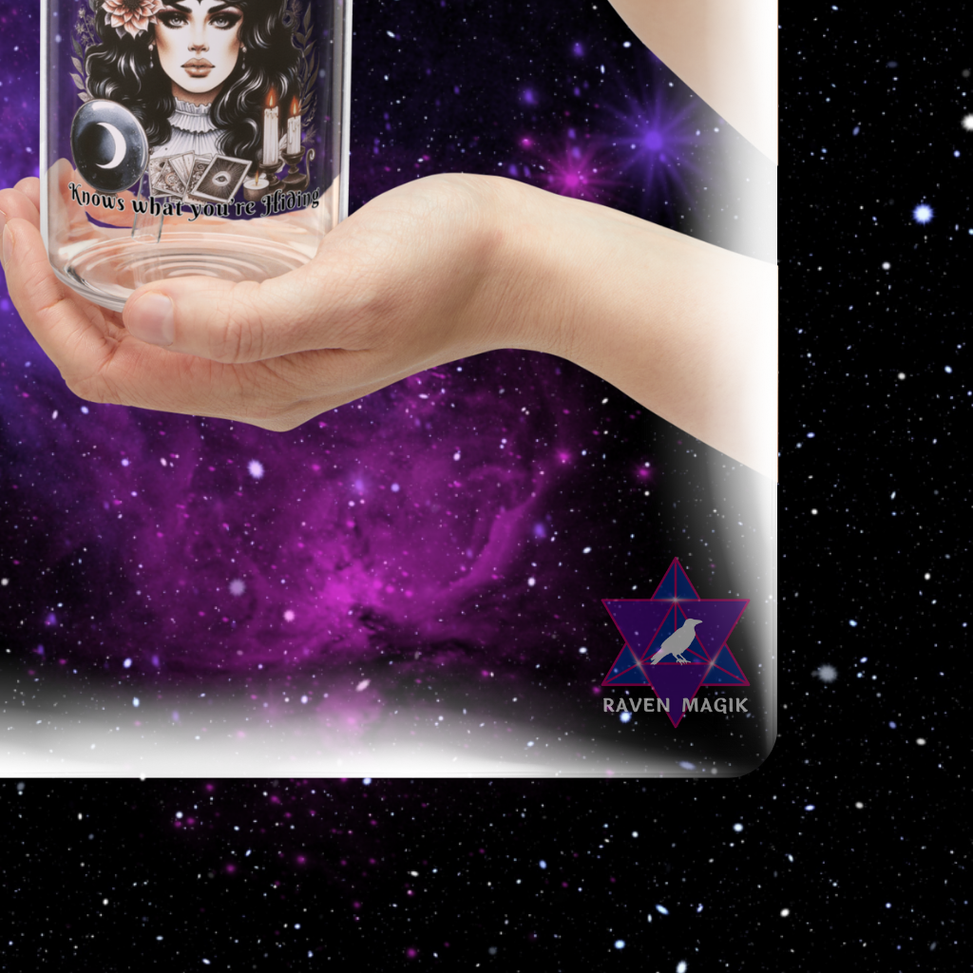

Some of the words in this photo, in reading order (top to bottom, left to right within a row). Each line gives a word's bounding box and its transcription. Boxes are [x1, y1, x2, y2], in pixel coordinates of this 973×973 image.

[68, 182, 125, 212] Knows
[131, 197, 183, 217] what
[260, 188, 320, 218] Hiding
